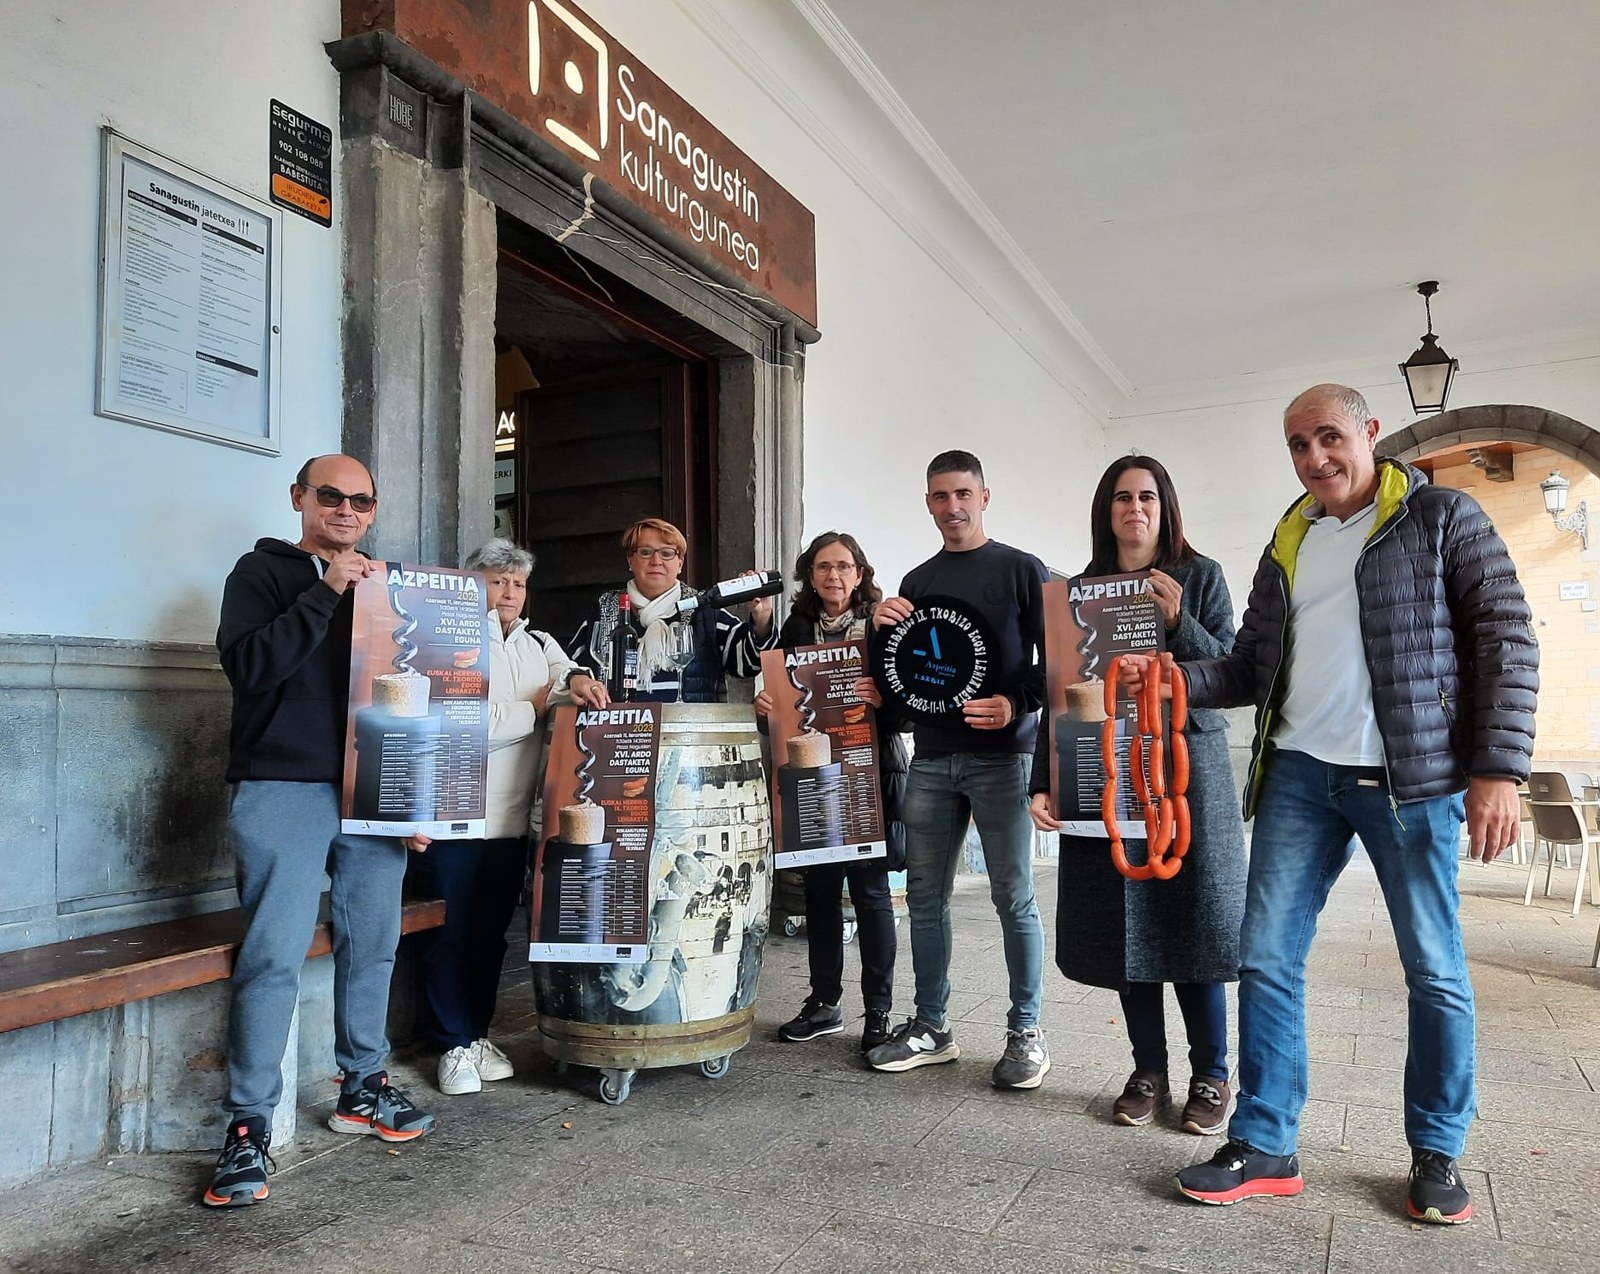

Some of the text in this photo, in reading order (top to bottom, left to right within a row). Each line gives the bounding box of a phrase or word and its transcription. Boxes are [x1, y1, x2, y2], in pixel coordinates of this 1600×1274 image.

[390, 94, 412, 130] HOBE
[272, 104, 330, 142] segurma
[272, 120, 296, 136] NEVER
[279, 140, 292, 154] 902
[295, 148, 308, 162] 108
[616, 64, 759, 222] Sanagustin
[150, 182, 200, 213] Sanagustin
[201, 205, 235, 228] jatetxea
[620, 123, 759, 272] kulturgunea
[388, 570, 479, 592] AZPEITIA
[1069, 578, 1155, 602] AZPEITIA
[457, 592, 479, 601] 2023
[1132, 594, 1153, 604] 202
[435, 627, 480, 635] DASTAKETA
[930, 607, 972, 631] TXORIZO
[968, 629, 986, 656] EGOSI
[1113, 631, 1156, 640] DASTAKETA
[785, 646, 862, 667] AZPEITIA
[843, 659, 862, 667] 2023
[925, 661, 956, 673] Azpeitia
[906, 694, 946, 714] 2023-11-11
[575, 709, 654, 726] AZPEITIA
[633, 724, 654, 732] 2023
